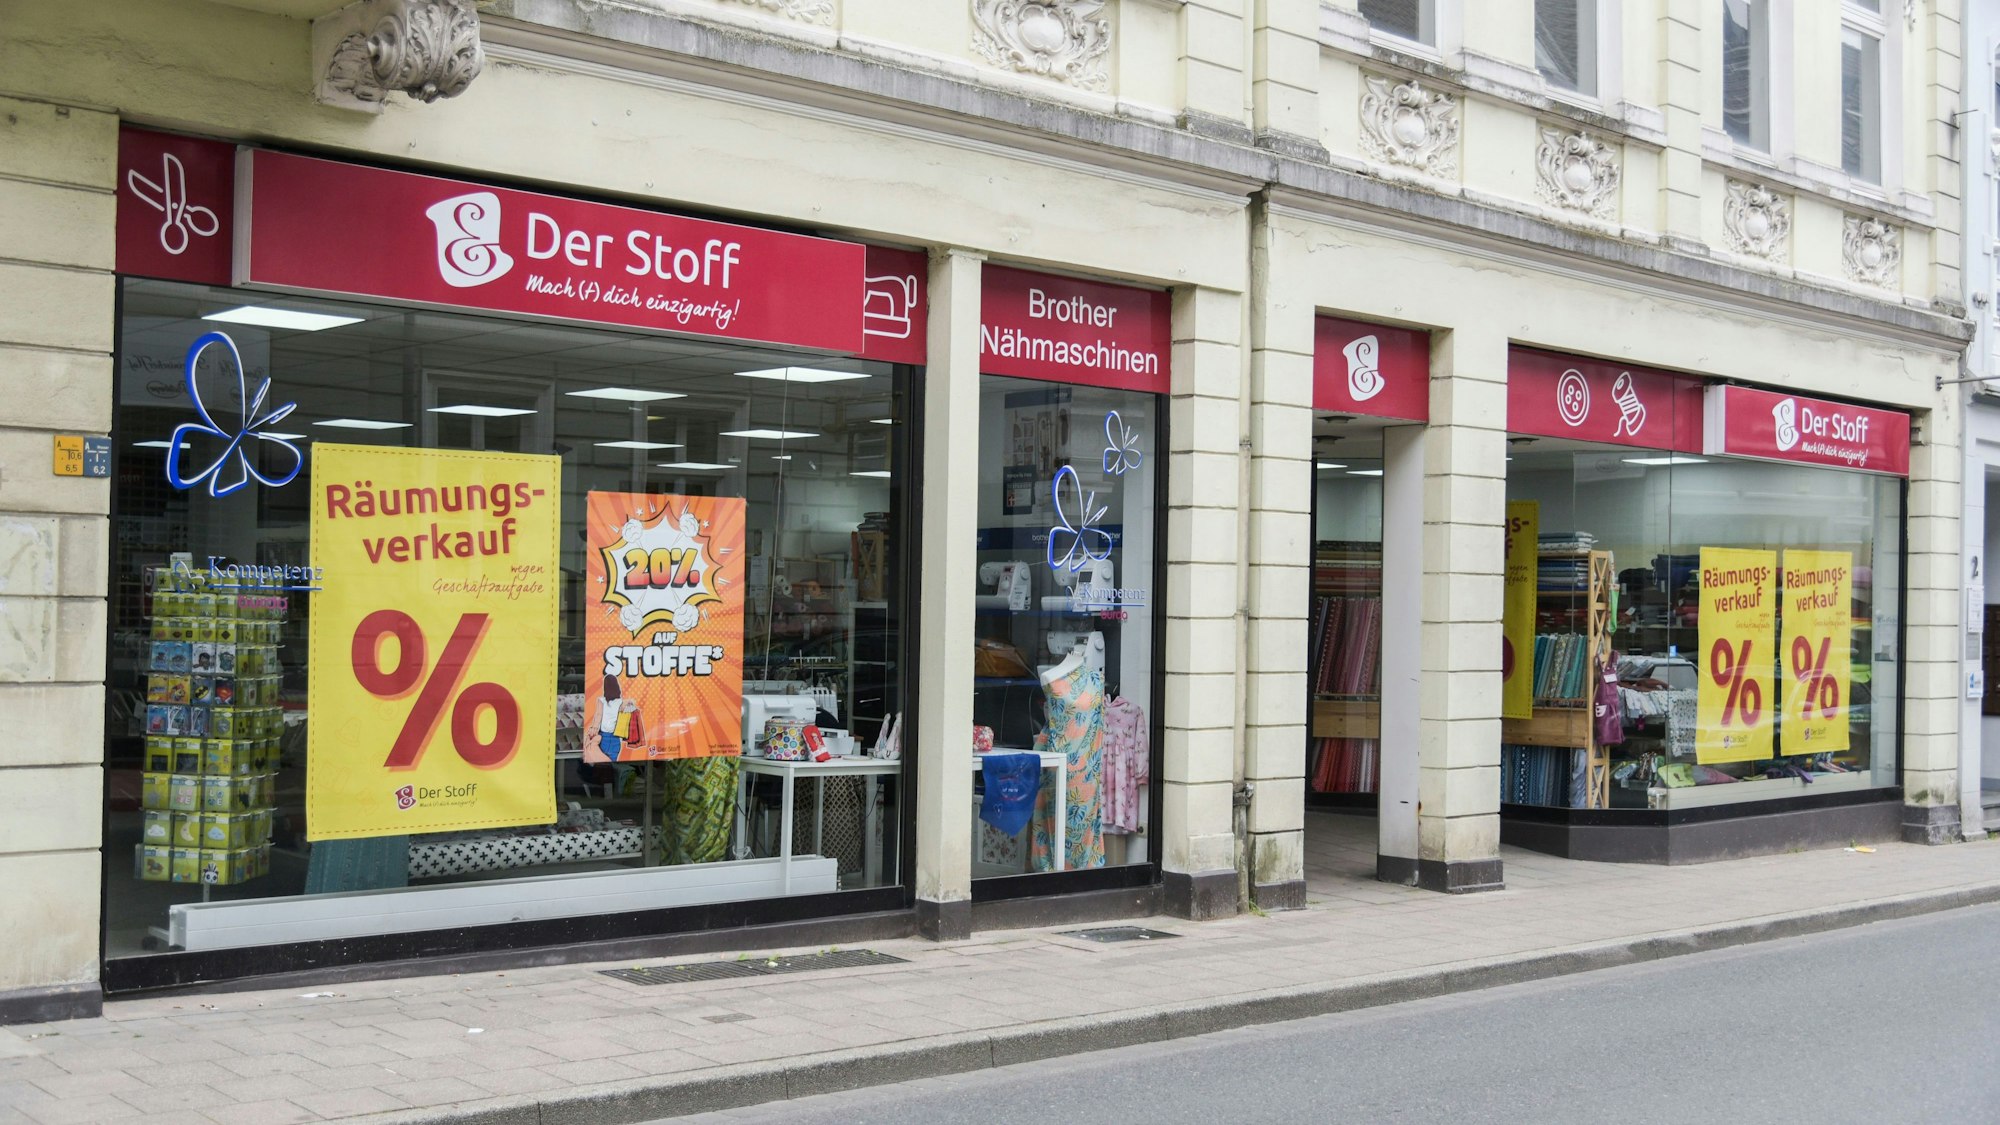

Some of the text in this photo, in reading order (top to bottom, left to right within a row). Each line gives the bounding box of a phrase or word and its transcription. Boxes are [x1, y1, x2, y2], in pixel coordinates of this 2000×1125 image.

[527, 212, 741, 288] Der Stoff
[525, 274, 741, 330] Mach (t) dich einzigartig!
[1029, 288, 1117, 328] Brother
[980, 324, 1158, 375] Nähmaschinen
[1802, 407, 1869, 443] Der Stoff
[57, 440, 62, 448] A
[85, 442, 90, 450] A
[1801, 441, 1817, 454] Mach
[1825, 444, 1837, 457] dich
[1838, 449, 1869, 467] einzigartig!
[65, 464, 78, 473] 6,5
[93, 465, 106, 475] 6,2
[326, 480, 545, 519] Räumungs-
[363, 517, 517, 564] verkauf
[208, 555, 324, 585] Kompetenz
[510, 563, 544, 581] wegen
[623, 547, 701, 590] 20%
[1703, 566, 1771, 589] Räumungs-
[1786, 567, 1847, 590] Räumungs-
[1972, 555, 1979, 578] 2
[432, 574, 544, 600] Geschäftsaufgabe
[1085, 582, 1147, 603] Kompetenz
[1715, 586, 1762, 613] verkauf
[1796, 586, 1839, 612] verkauf
[1100, 608, 1128, 620] burda
[652, 631, 678, 646] AUF
[351, 609, 524, 773] %
[1710, 637, 1762, 728] %
[1791, 635, 1839, 721] %
[419, 783, 477, 800] Der Stoff
